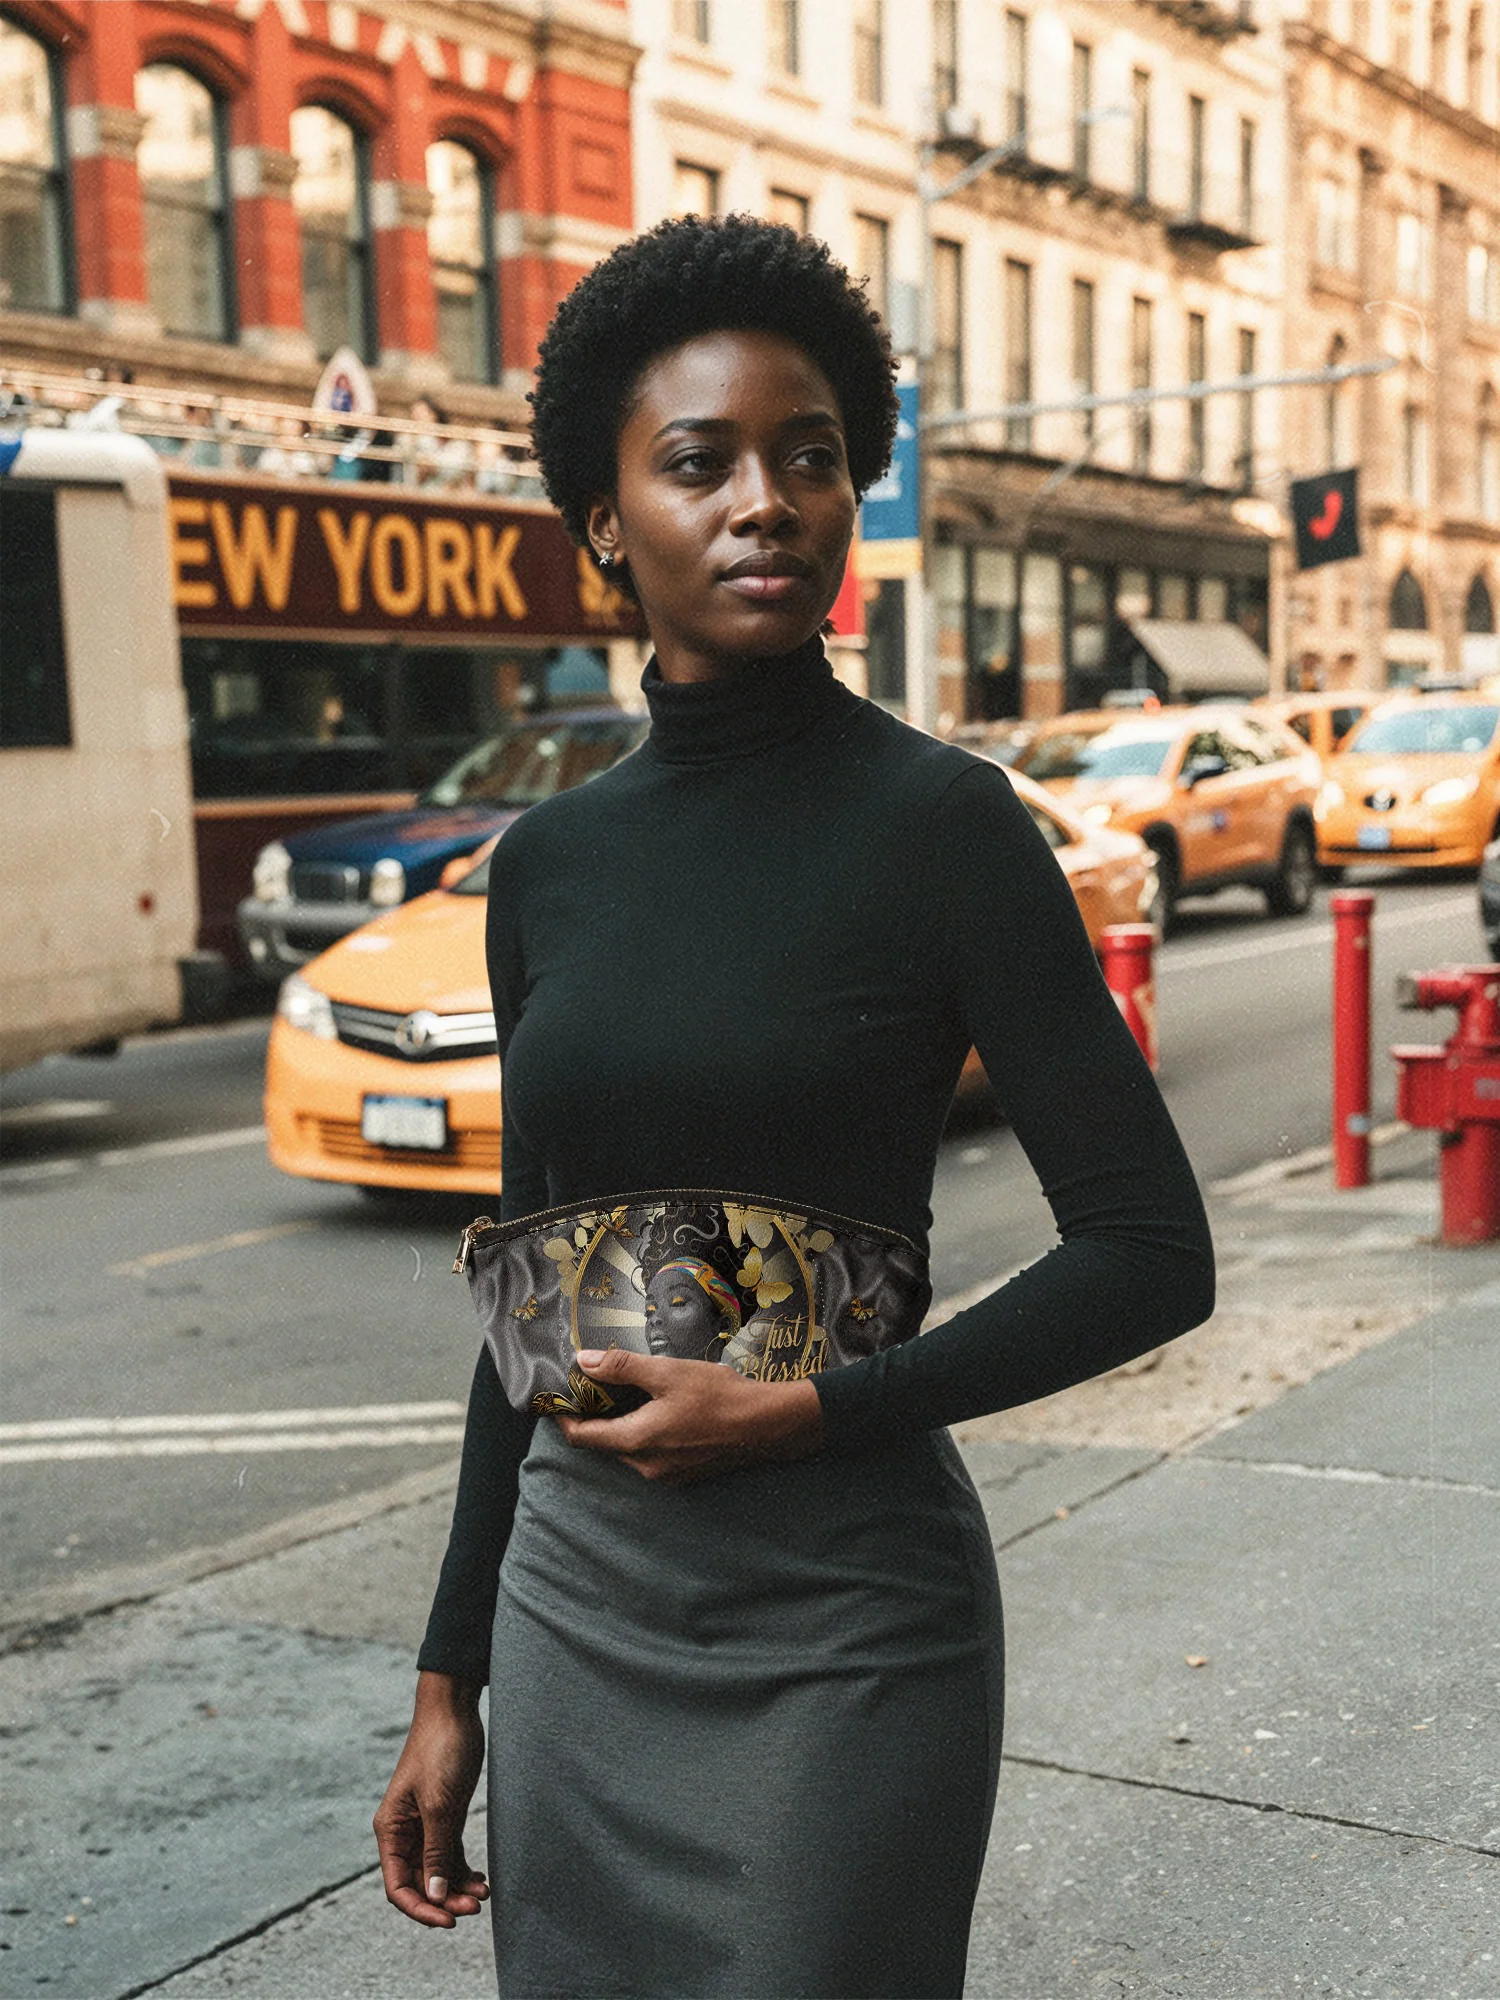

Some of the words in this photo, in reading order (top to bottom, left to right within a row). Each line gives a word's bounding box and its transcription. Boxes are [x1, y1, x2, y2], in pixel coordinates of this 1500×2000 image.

[168, 498, 298, 612] EW
[317, 508, 528, 620] YORK
[750, 1313, 808, 1357] Just
